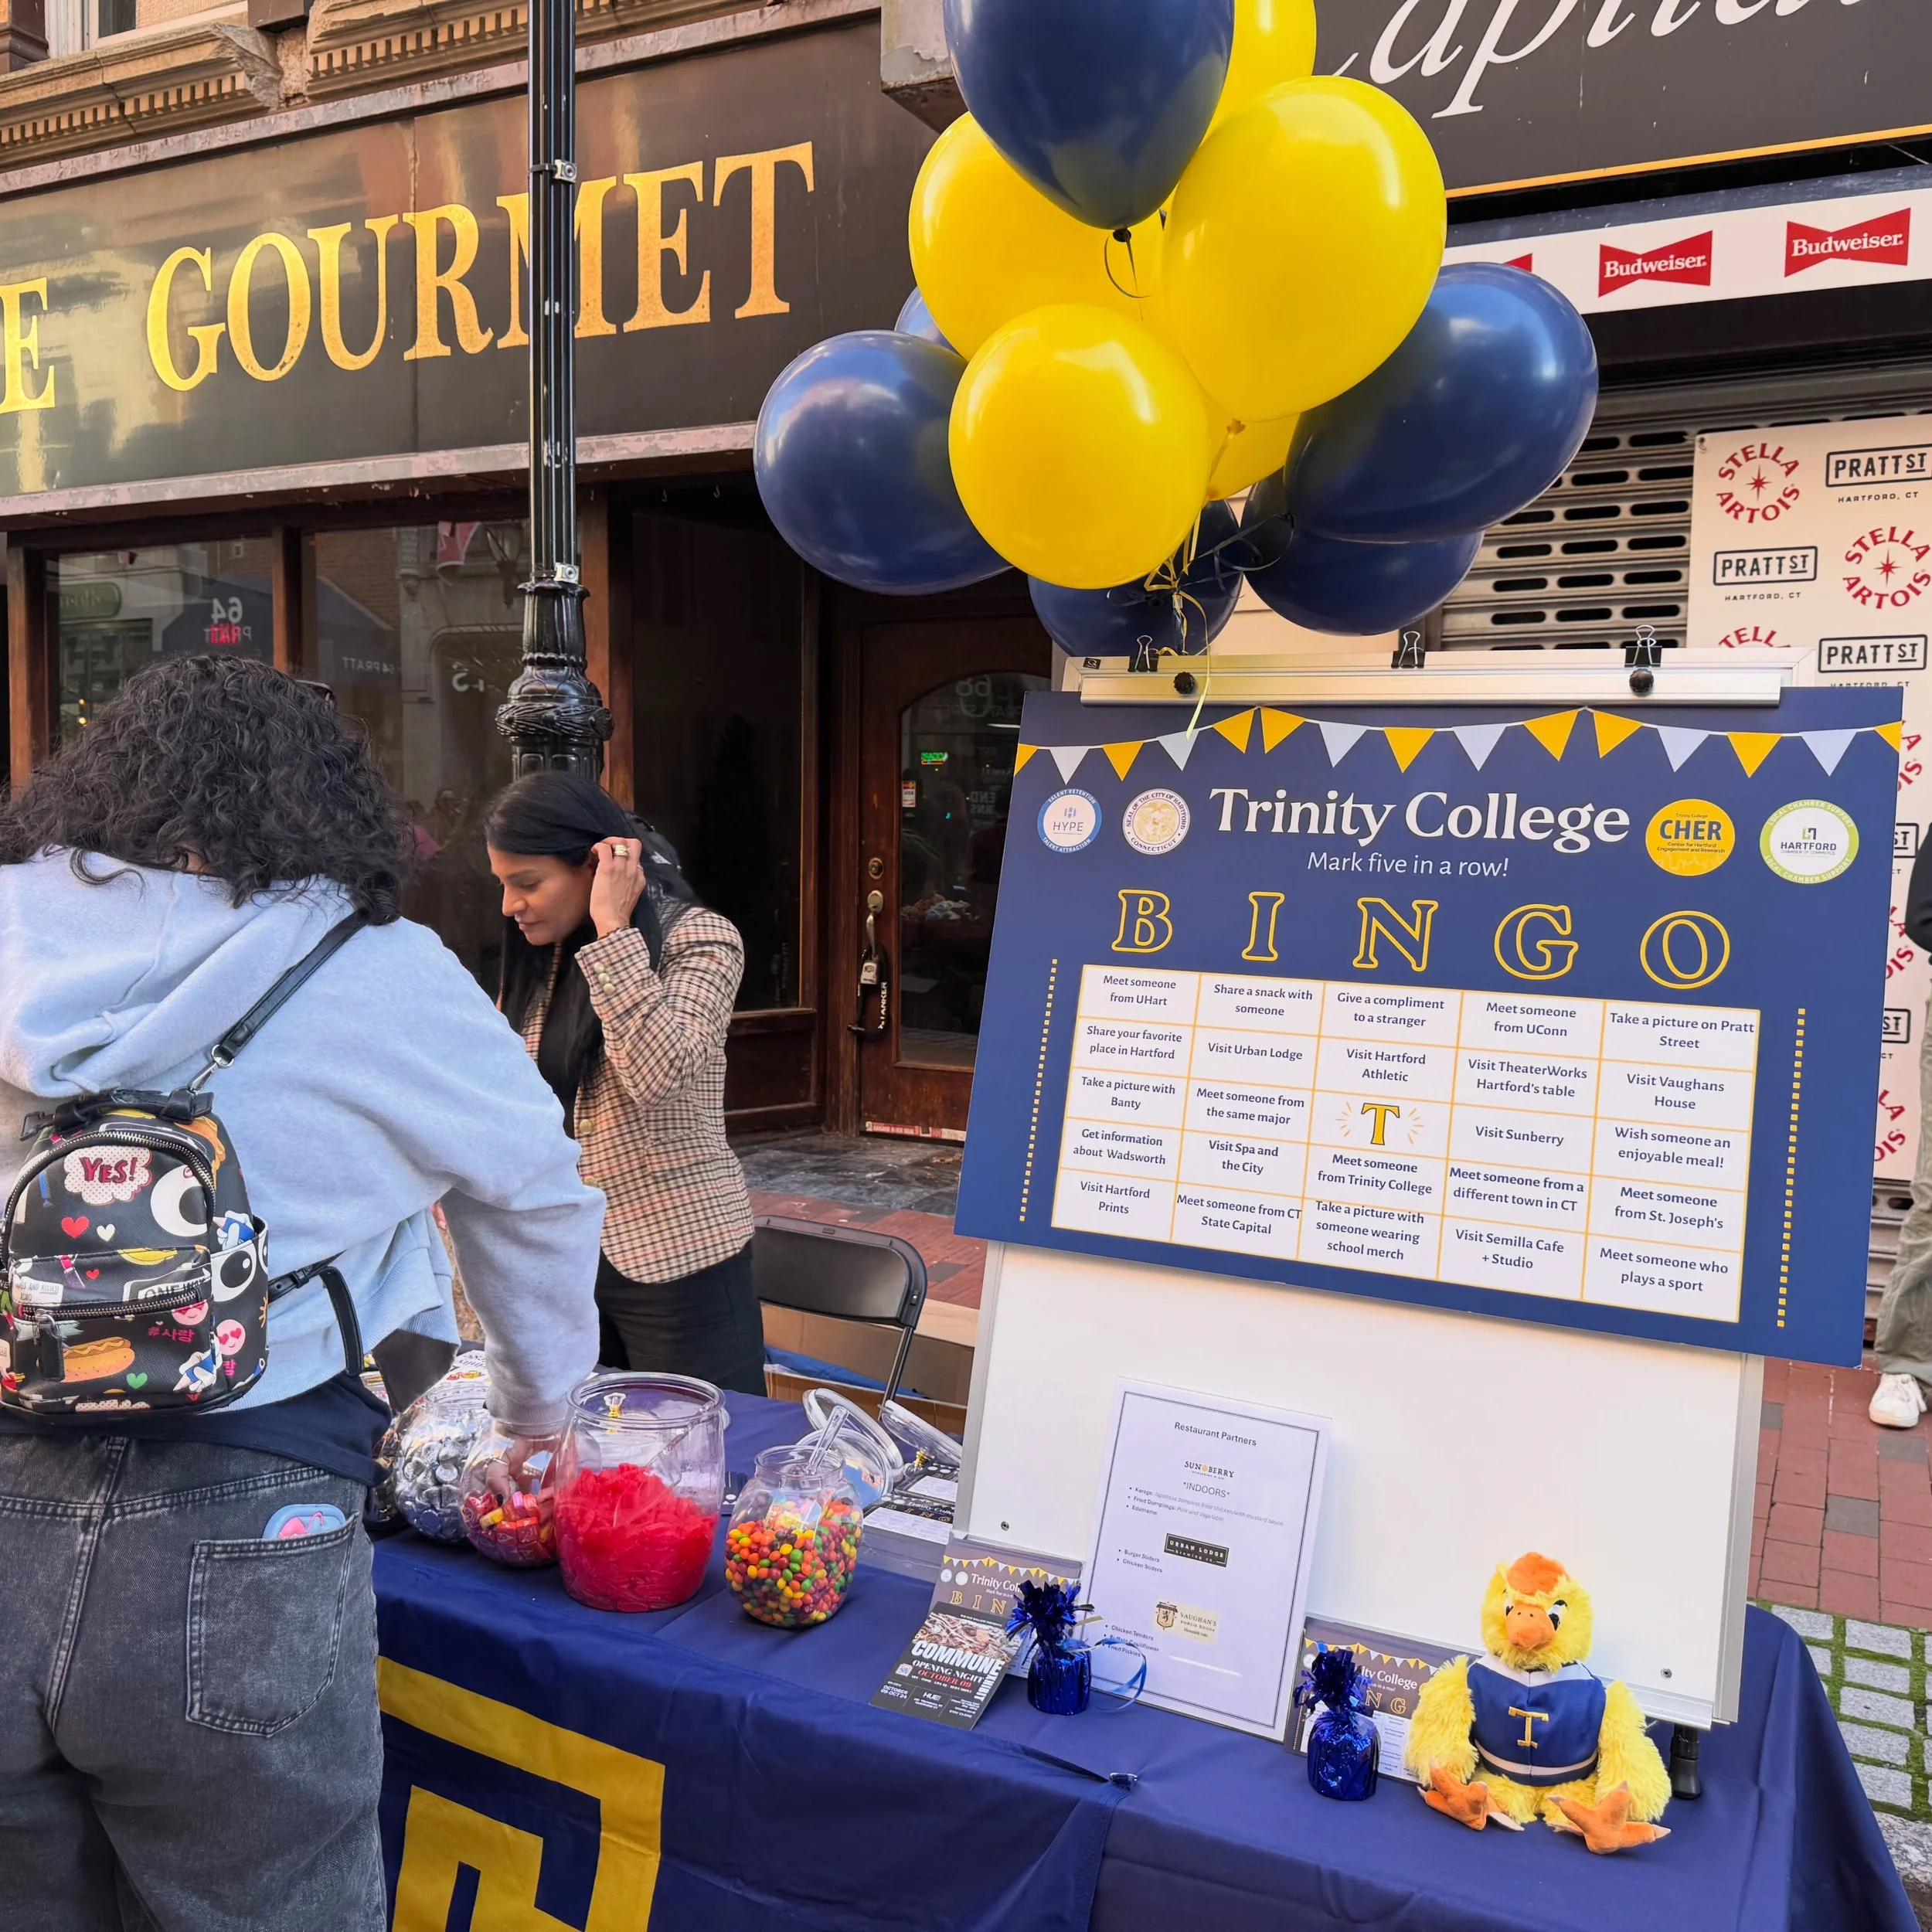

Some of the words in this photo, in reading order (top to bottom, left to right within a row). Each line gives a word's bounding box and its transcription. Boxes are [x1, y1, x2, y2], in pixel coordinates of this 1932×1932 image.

[1718, 443, 1800, 481] STELLA
[1835, 456, 1903, 479] PRATT
[1906, 453, 1927, 473] ST
[1716, 485, 1801, 524] ARTOIS
[1845, 526, 1930, 565] STELLA
[1722, 556, 1786, 578] PRATT
[1789, 554, 1809, 573] ST
[1842, 570, 1932, 610] ARTOIS
[1826, 645, 1894, 665] PRATT
[1897, 643, 1919, 662] ST
[1069, 788, 1097, 804] RETENTION
[1138, 794, 1151, 804] THE
[1172, 798, 1187, 830] HARTFORD
[1209, 788, 1397, 847] Trinity
[1405, 791, 1630, 853] College
[1769, 808, 1788, 825] LOCAL
[1788, 800, 1825, 810] CHAMBER
[1826, 803, 1854, 828] SUPPORT
[1053, 821, 1083, 832] HYPE
[1659, 819, 1723, 841] CHER
[1131, 837, 1176, 852] CONNECTICUT
[1781, 842, 1837, 851] HARTFORD
[1308, 852, 1362, 872] Mark
[1368, 852, 1407, 873] five
[1413, 855, 1433, 874] in
[1439, 860, 1452, 875] a
[1458, 858, 1509, 877] row!
[1765, 855, 1782, 874] LOCAL
[1783, 872, 1821, 883] CHAMBER
[1821, 858, 1851, 880] SUPPORT
[1111, 889, 1173, 954] B
[1241, 891, 1285, 962] I
[1352, 897, 1438, 972] N
[1493, 903, 1578, 981] G
[1639, 910, 1730, 989] O
[1213, 984, 1245, 995] Share
[1255, 988, 1286, 998] snack
[1288, 989, 1313, 1000] with
[1235, 1005, 1284, 1016] someone
[1610, 1012, 1639, 1025] Take
[1642, 1017, 1649, 1026] a
[1652, 1015, 1699, 1029] picture
[1701, 1022, 1717, 1030] on
[1721, 1020, 1754, 1033] Pratt
[1208, 1043, 1232, 1053] Visit
[1234, 1045, 1267, 1056] Urban
[1270, 1048, 1303, 1062] Lodge
[1659, 1036, 1700, 1049] Street
[1468, 1059, 1496, 1071] Visit
[1498, 1061, 1587, 1079] TheaterWorks
[1081, 1076, 1104, 1087] Take
[1114, 1080, 1150, 1092] picture
[1152, 1083, 1175, 1094] with
[1477, 1078, 1539, 1094] Hartford's
[1543, 1084, 1575, 1097] table
[1111, 1097, 1141, 1111] Banty
[1361, 1103, 1400, 1145] T
[1615, 1127, 1648, 1141] Wish
[1651, 1133, 1712, 1147] someone
[1714, 1139, 1730, 1148] an
[1209, 1140, 1233, 1151] Visit
[1235, 1143, 1255, 1155] Spa
[1257, 1146, 1279, 1157] and
[1618, 1148, 1683, 1164] enjoyable
[1686, 1156, 1723, 1168] meal!
[80, 1157, 137, 1184] YES!
[1222, 1159, 1240, 1171] the
[1242, 1162, 1264, 1175] City
[1080, 1181, 1104, 1193] Visit
[1105, 1184, 1150, 1199] Hartford
[1098, 1201, 1129, 1214] Prints
[1316, 1200, 1342, 1214] Take
[1343, 1206, 1352, 1214] a
[1353, 1205, 1396, 1221] picture
[1396, 1211, 1425, 1224] with
[1315, 1222, 1369, 1236] someone
[1371, 1229, 1420, 1245] wearing
[1327, 1240, 1364, 1255] school
[1366, 1248, 1403, 1260] merch
[1174, 1421, 1219, 1439] Restaurant
[1221, 1431, 1257, 1447] Partners
[1133, 1495, 1147, 1504] Fried
[1169, 1539, 1196, 1551] URBAN
[1199, 1546, 1224, 1559] LODGE
[1180, 1611, 1217, 1627] VAUGHAN'S
[1111, 1624, 1133, 1635] Chicken
[1133, 1631, 1154, 1641] Tenders
[910, 1640, 1005, 1675] COMMUNE
[912, 1659, 952, 1675] OPENING
[953, 1669, 985, 1684] NIGHT
[917, 1669, 960, 1685] OCTOBER
[1376, 1670, 1417, 1690] College
